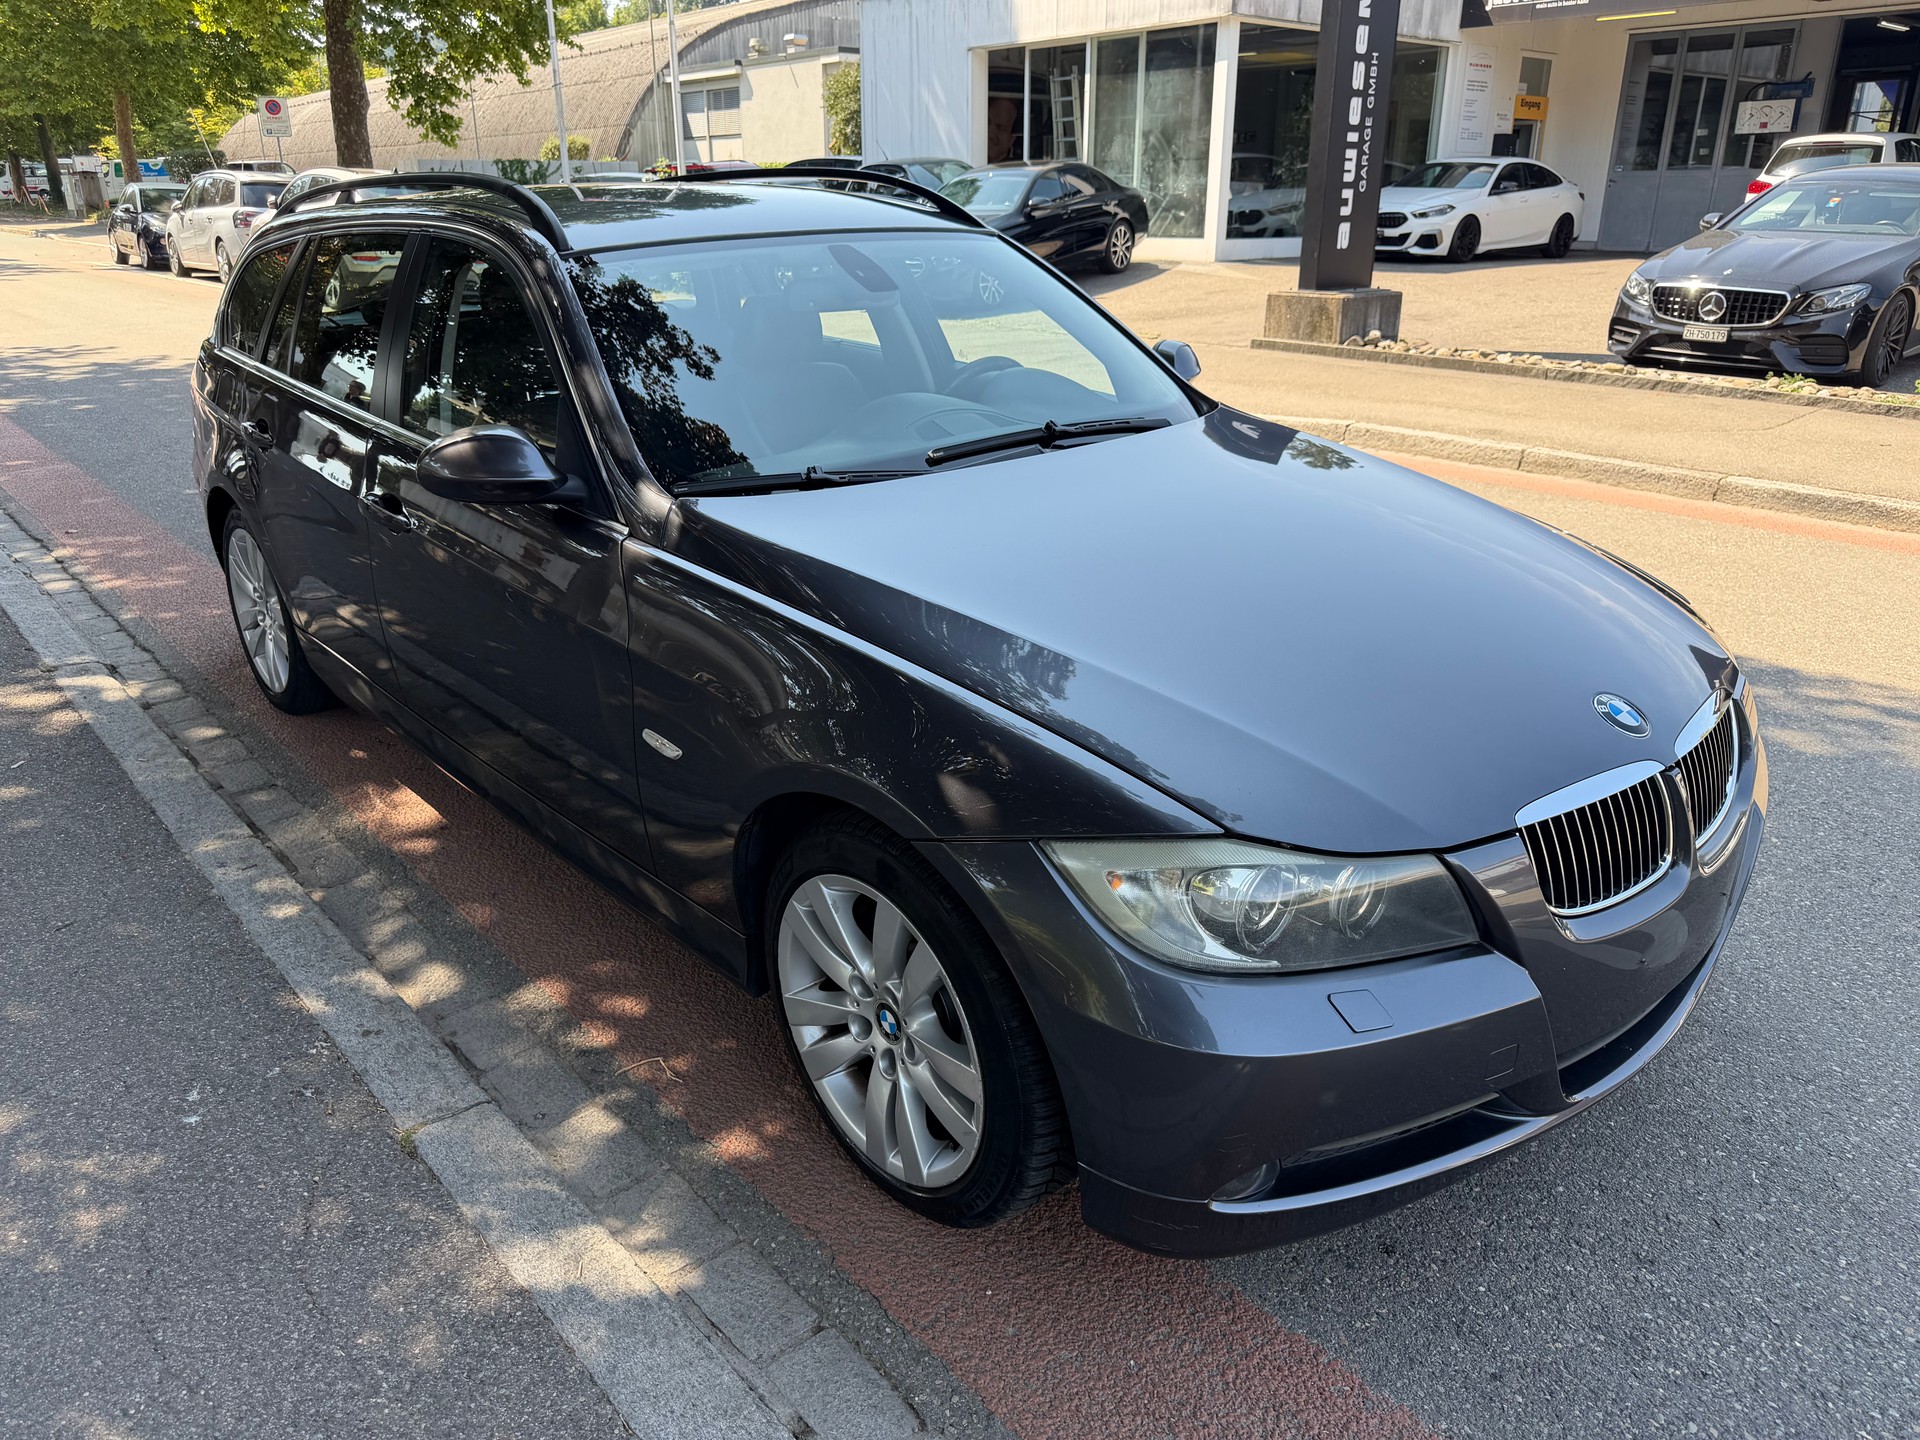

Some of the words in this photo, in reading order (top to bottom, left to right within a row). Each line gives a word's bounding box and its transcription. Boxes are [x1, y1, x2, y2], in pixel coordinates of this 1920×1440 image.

[1359, 117, 1373, 192] GARAGE
[1366, 52, 1379, 109] GMBH
[1520, 98, 1541, 111] Eingang
